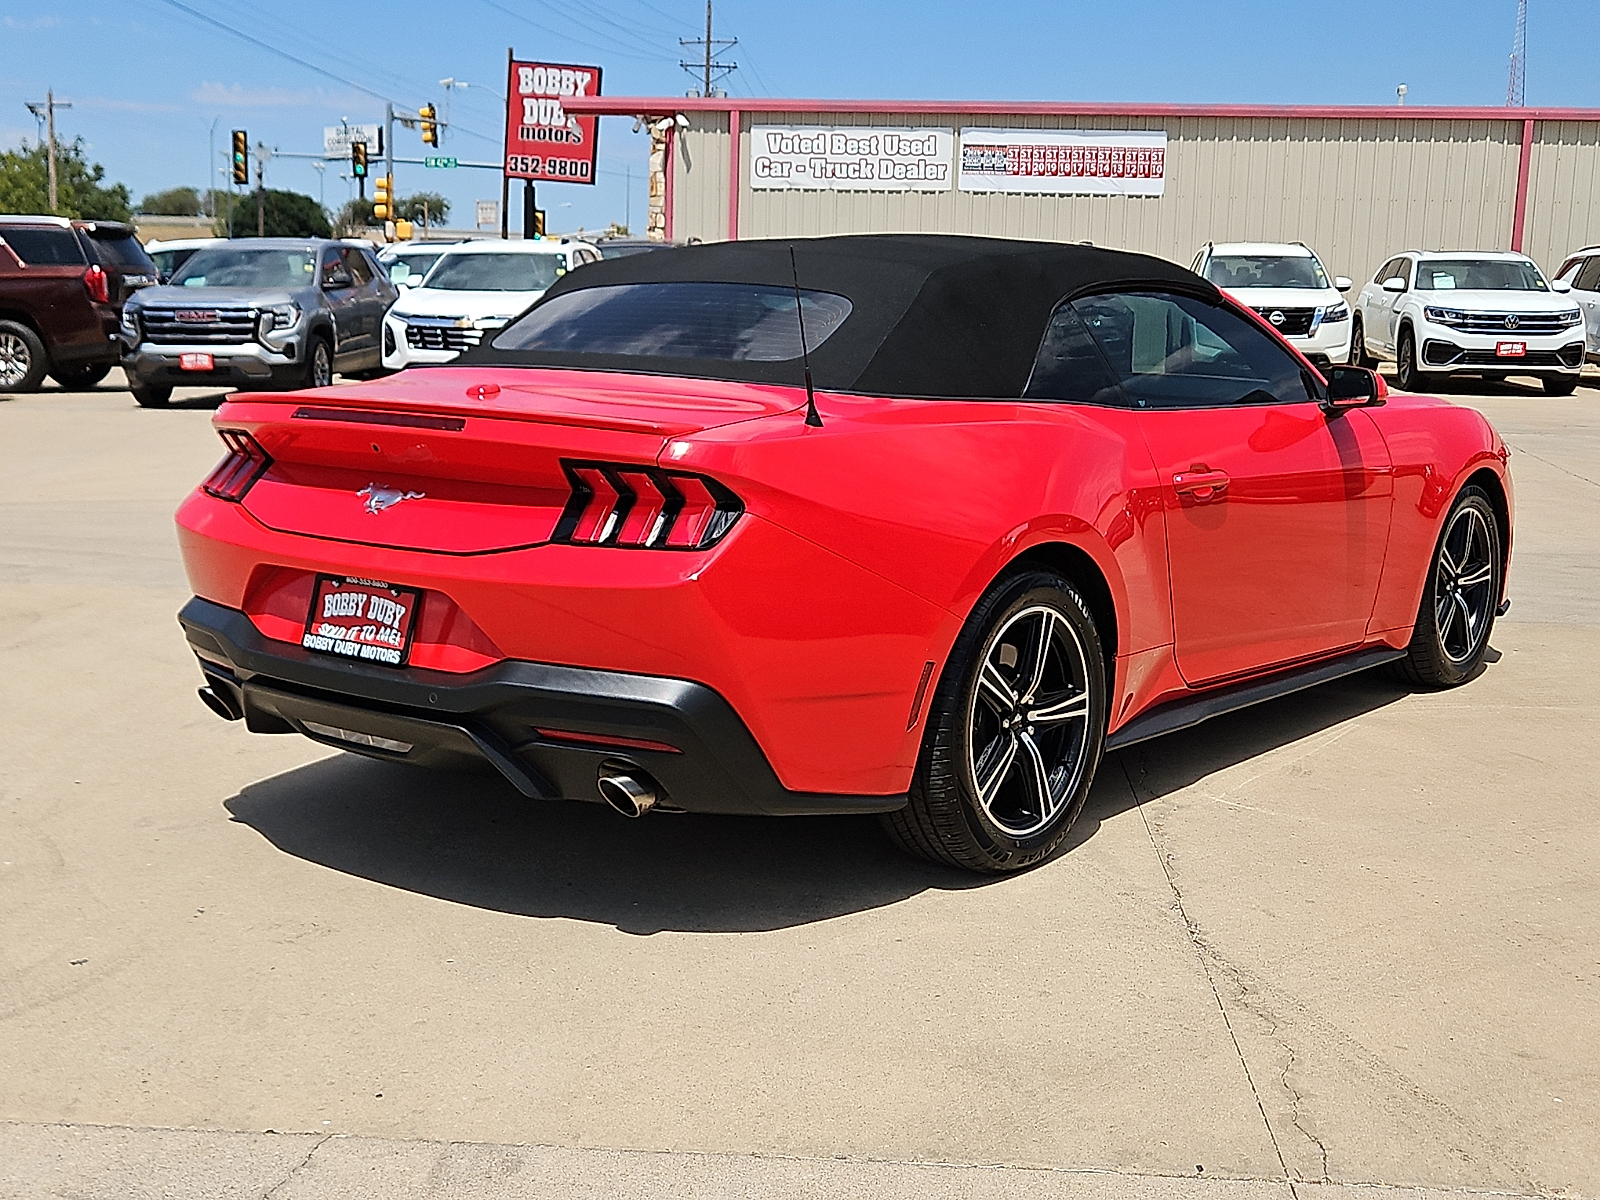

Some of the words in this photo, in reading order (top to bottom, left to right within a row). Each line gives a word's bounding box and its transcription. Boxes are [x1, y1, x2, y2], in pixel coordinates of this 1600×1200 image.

[518, 67, 591, 97] BOBBY
[522, 98, 577, 128] DUB
[520, 126, 582, 143] motors
[767, 133, 825, 154] Voted
[830, 134, 879, 155] Best
[884, 135, 936, 156] Used
[1009, 149, 1019, 158] ST
[1021, 149, 1032, 158] ST
[1034, 149, 1045, 158] ST
[1047, 149, 1058, 158] ST
[1060, 150, 1071, 158] ST
[1072, 150, 1084, 159] ST
[1085, 150, 1097, 159] ST
[1099, 151, 1111, 160] ST
[1113, 151, 1125, 160] ST
[1127, 151, 1138, 160] ST
[1139, 151, 1150, 160] ST
[1152, 152, 1163, 160] ST
[509, 156, 589, 177] 352-9800
[755, 157, 791, 178] Car
[796, 164, 806, 173] -
[809, 158, 874, 179] Truck
[878, 159, 947, 180] Dealer
[1007, 162, 1019, 171] 22
[1021, 162, 1031, 171] 21
[1033, 163, 1044, 171] 20
[1046, 163, 1057, 172] 19
[1060, 163, 1070, 172] 18
[1073, 163, 1083, 172] 17
[1086, 163, 1096, 172] 15
[1099, 164, 1109, 173] 14
[1113, 164, 1122, 173] 13
[1126, 165, 1136, 173] 12
[1140, 165, 1149, 173] 11
[1153, 165, 1162, 174] 10
[177, 311, 216, 321] GMC
[323, 593, 367, 618] BOBBY
[367, 595, 406, 629] DUBY
[318, 623, 347, 639] SOLD
[345, 626, 361, 640] IT
[360, 625, 376, 640] TO
[376, 626, 401, 646] ME!
[303, 634, 335, 651] BOBBY
[334, 640, 361, 657] DUBY
[360, 645, 401, 664] MOTORS
